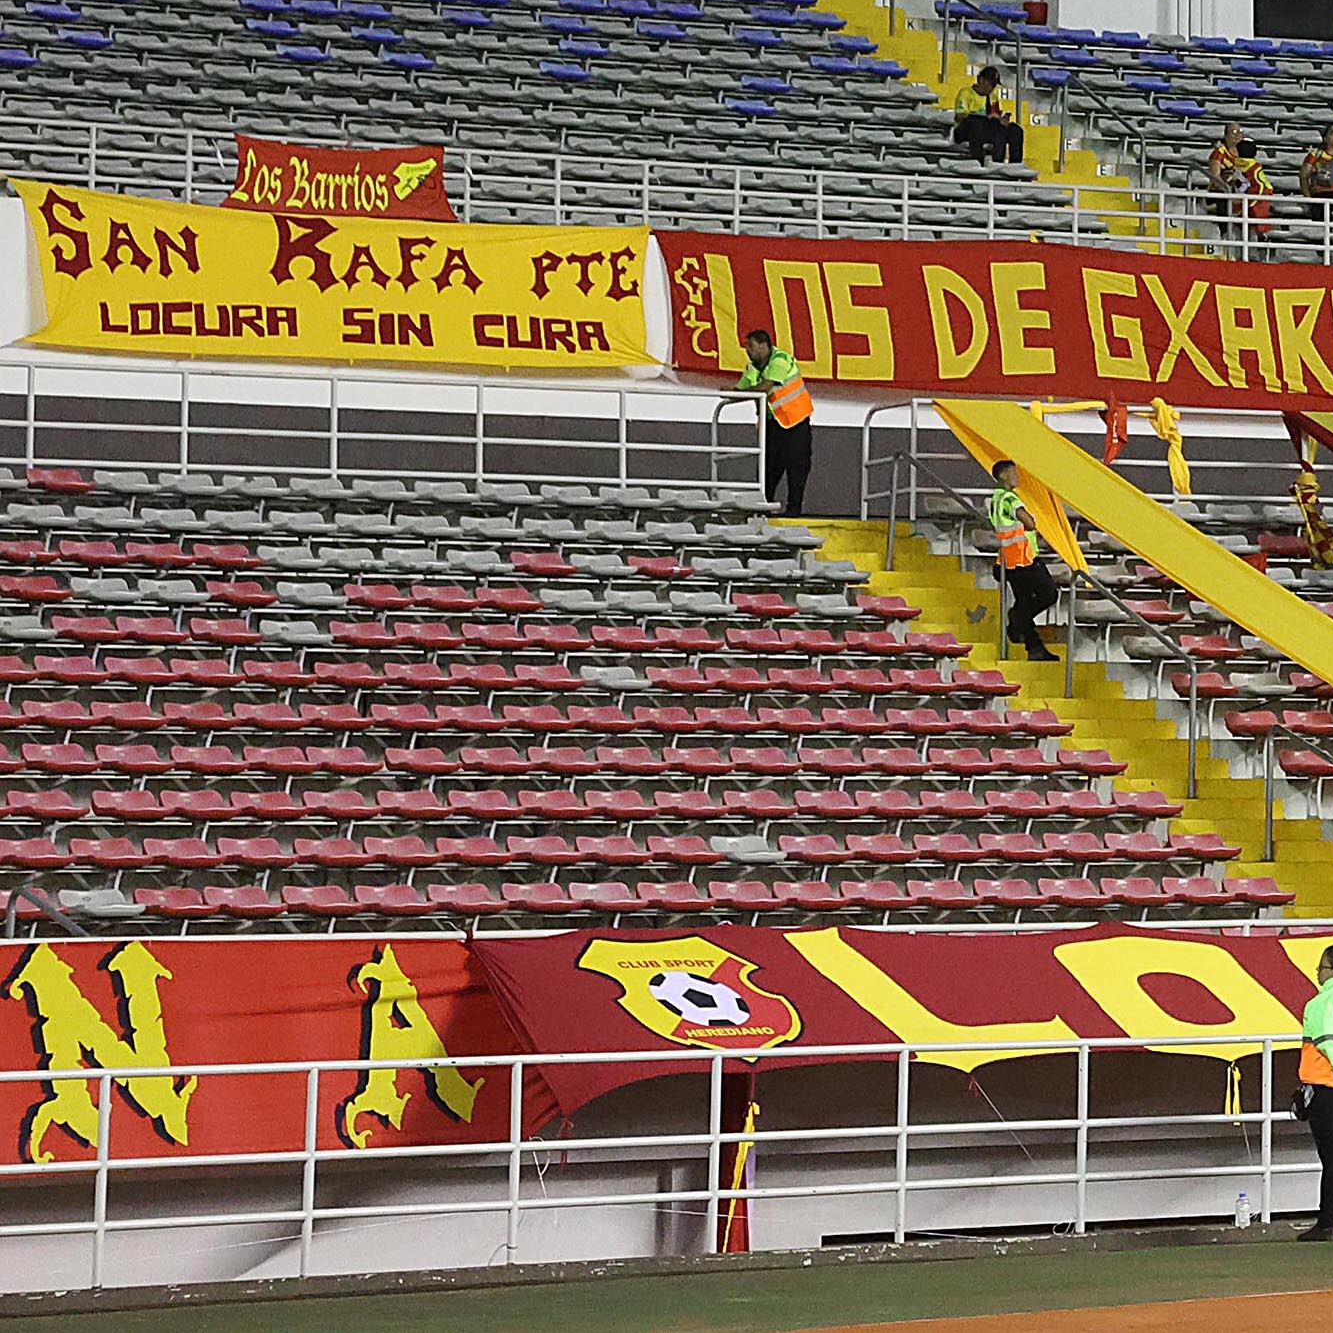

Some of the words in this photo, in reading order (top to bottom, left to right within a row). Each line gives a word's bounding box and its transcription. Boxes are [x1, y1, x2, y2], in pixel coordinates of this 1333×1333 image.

[230, 148, 283, 204] Los
[285, 156, 389, 212] Barrios
[100, 301, 298, 338] LOCURA
[341, 307, 435, 347] SIN
[471, 313, 610, 353] CURA
[703, 252, 894, 381] LOS
[922, 261, 1056, 380] DE
[617, 959, 660, 969] CLUB
[662, 958, 718, 969] SPORT
[684, 1026, 776, 1039] HEREDIANO
